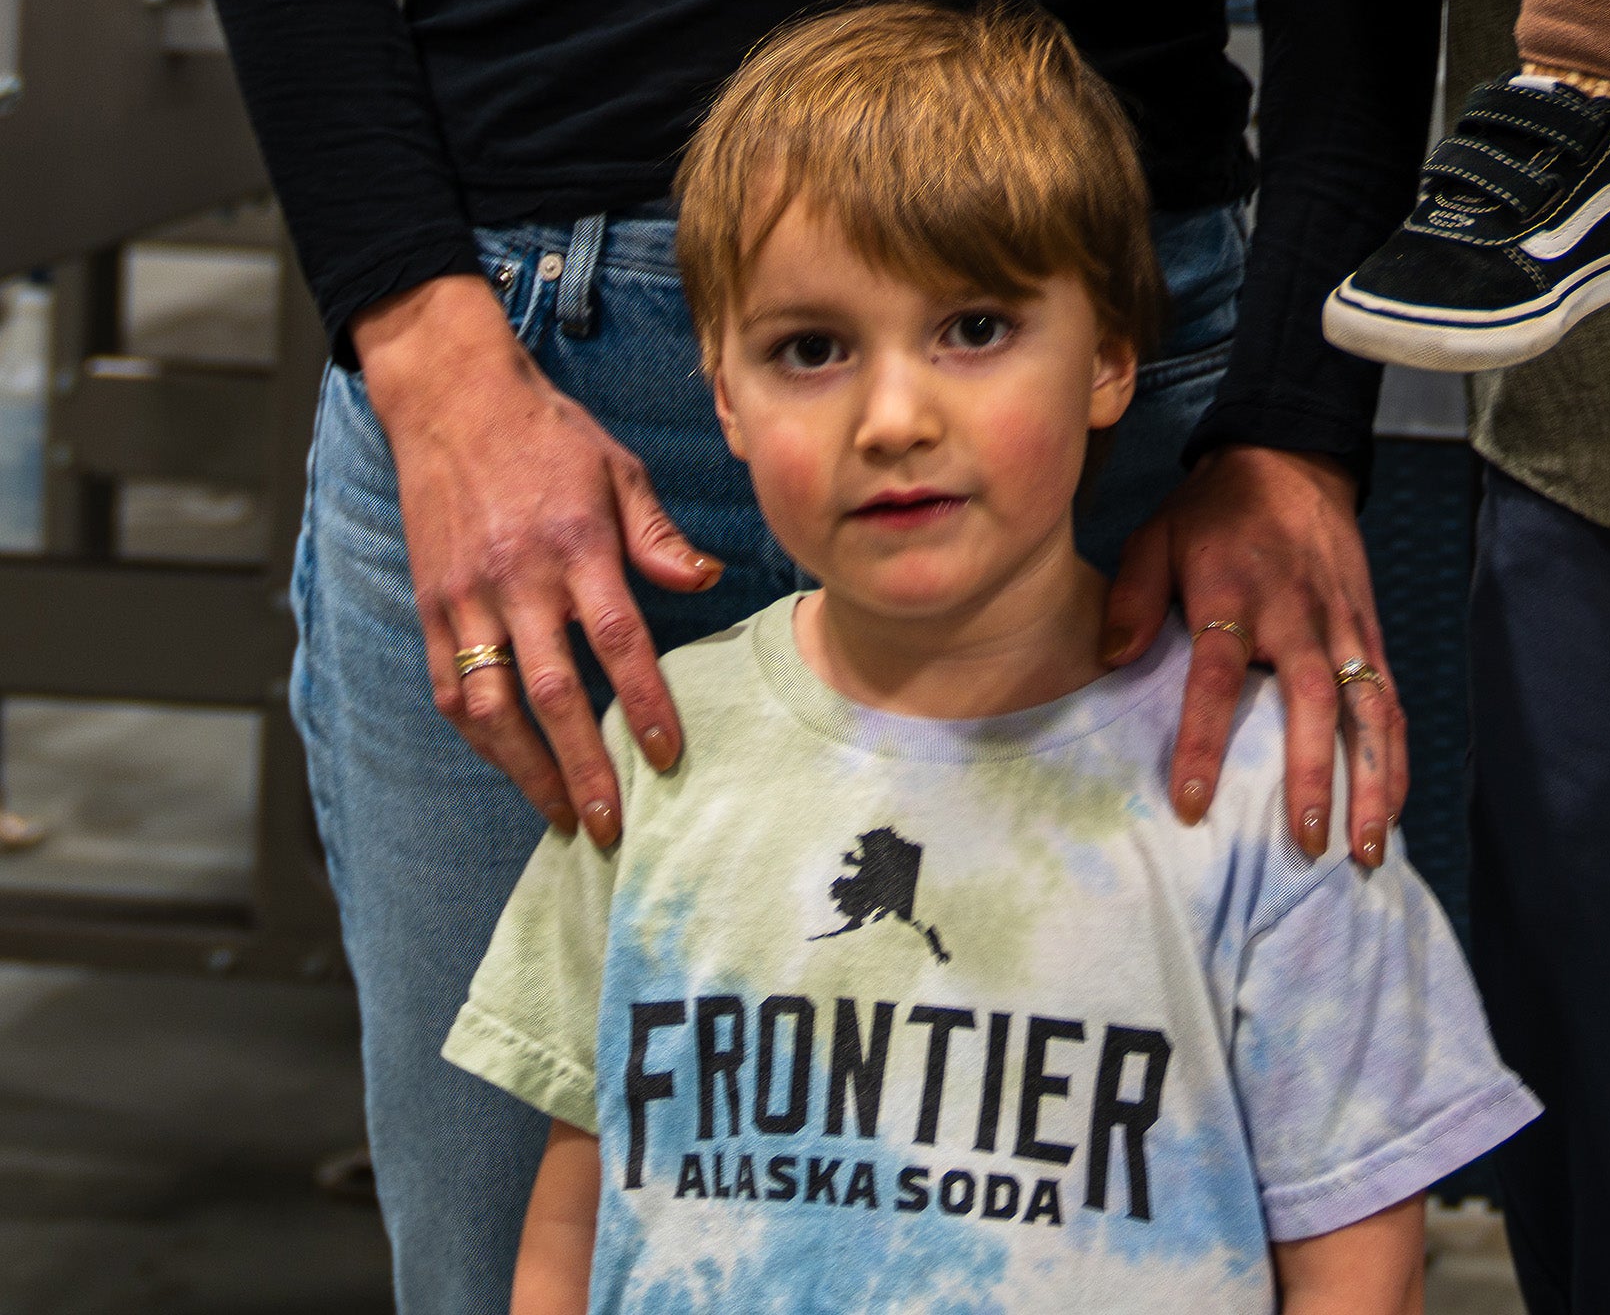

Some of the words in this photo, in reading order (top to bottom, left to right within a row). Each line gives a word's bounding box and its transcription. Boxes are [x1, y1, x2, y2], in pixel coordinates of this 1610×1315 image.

[624, 994, 1172, 1221] FRONTIER
[674, 1151, 879, 1209] ALASKA
[894, 1166, 1062, 1226] SODA
